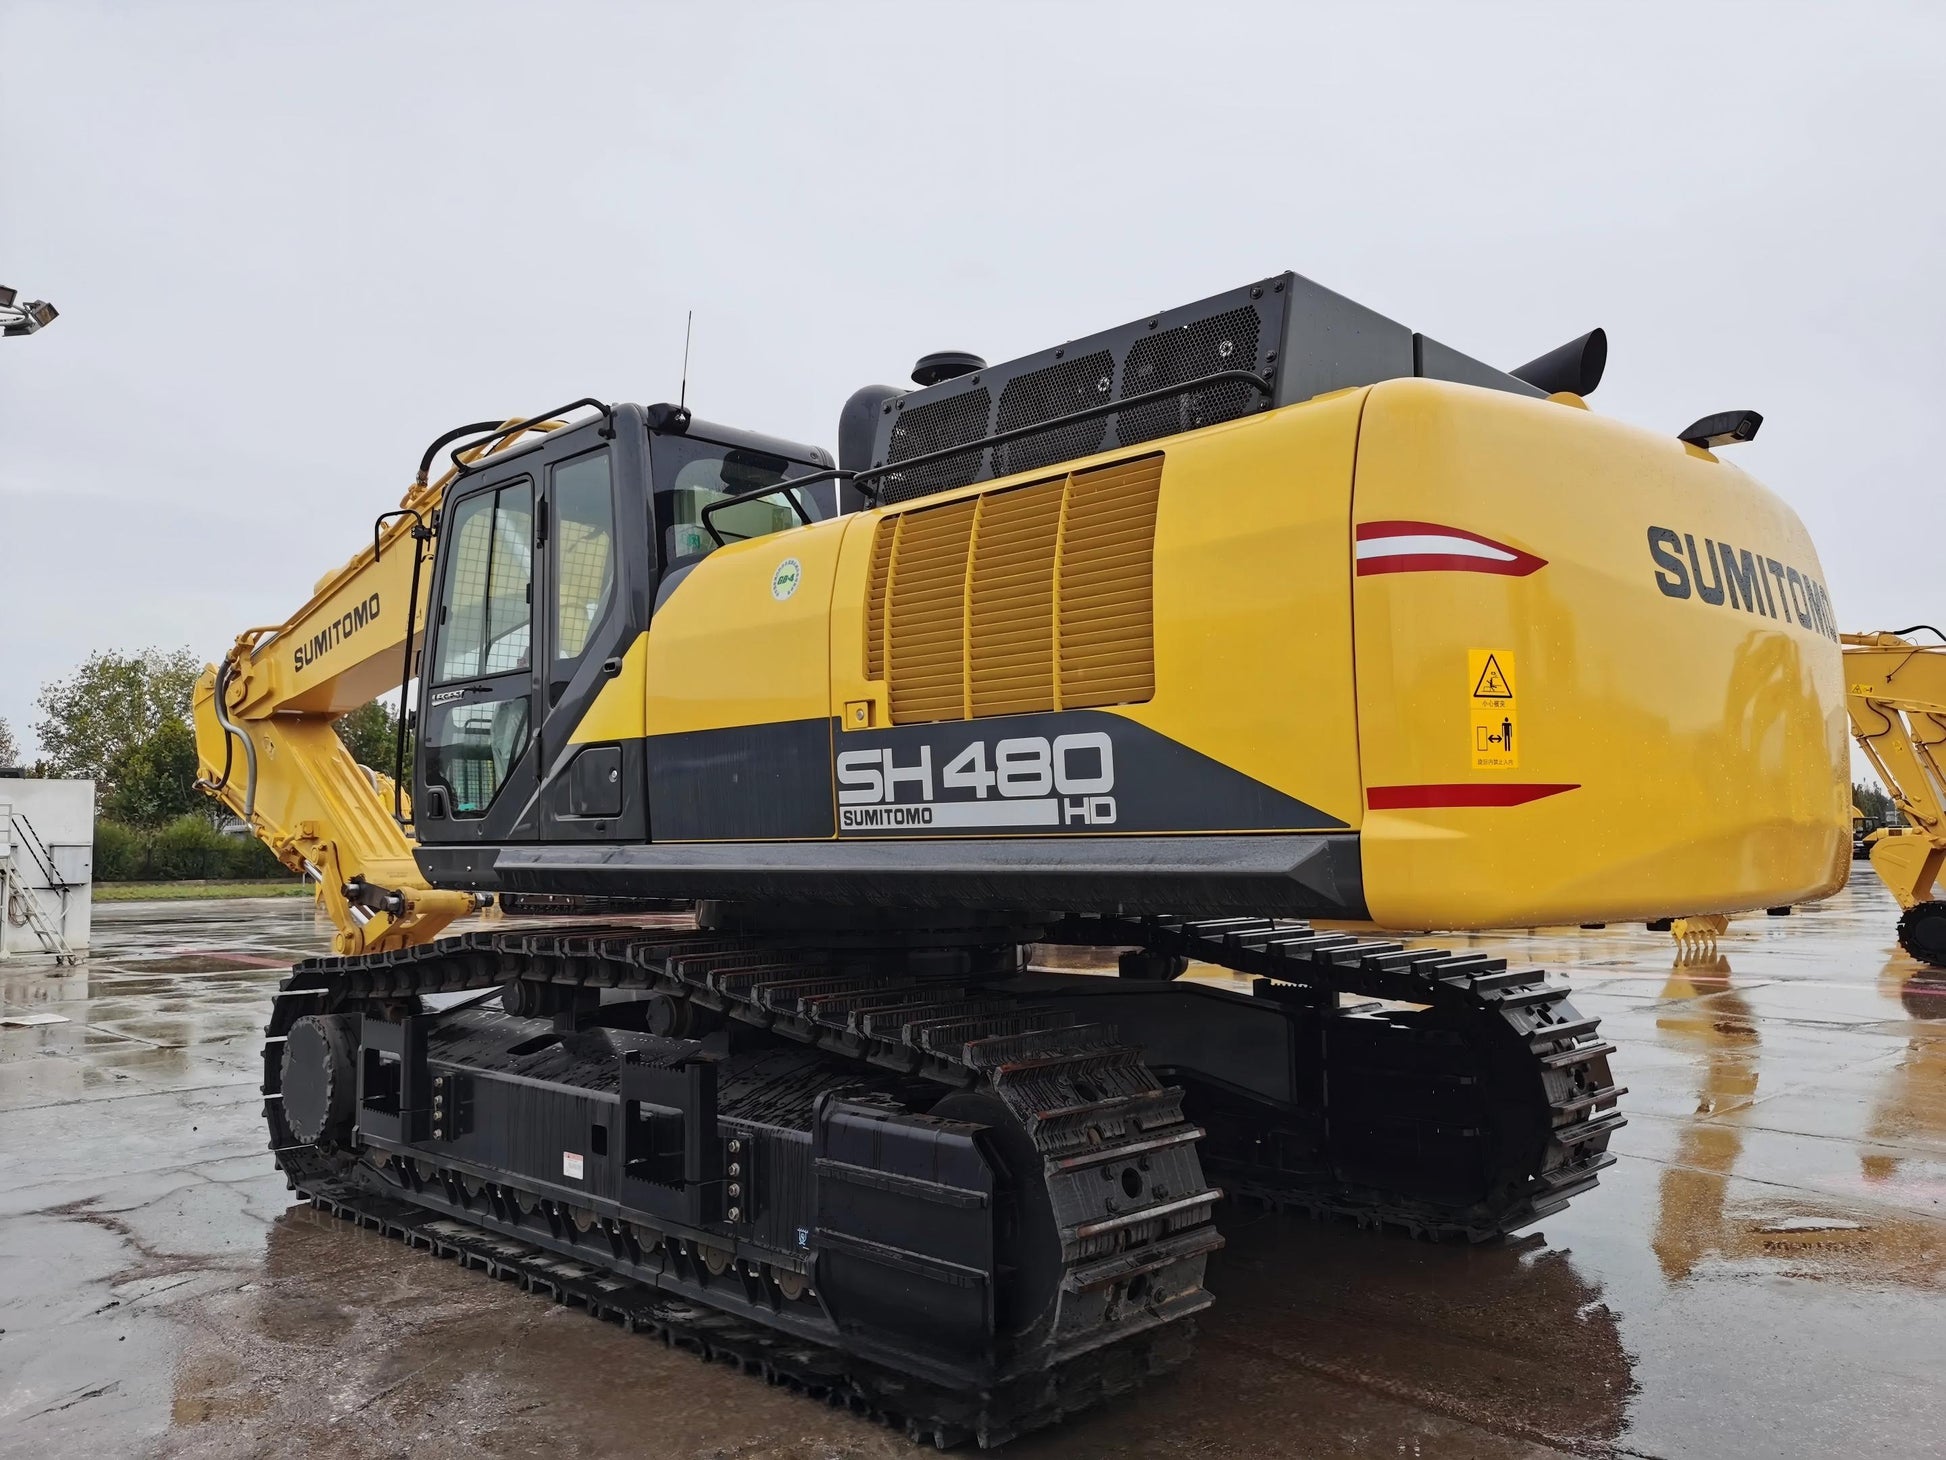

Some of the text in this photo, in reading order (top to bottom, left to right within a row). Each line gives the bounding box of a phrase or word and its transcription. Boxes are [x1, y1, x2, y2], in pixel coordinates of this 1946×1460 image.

[1647, 526, 1838, 643] SUMITOMO
[294, 592, 380, 673] SUMITOMO
[837, 732, 1114, 804] SH 480
[844, 807, 932, 826] SUMITOMO
[1064, 796, 1117, 825] HD
